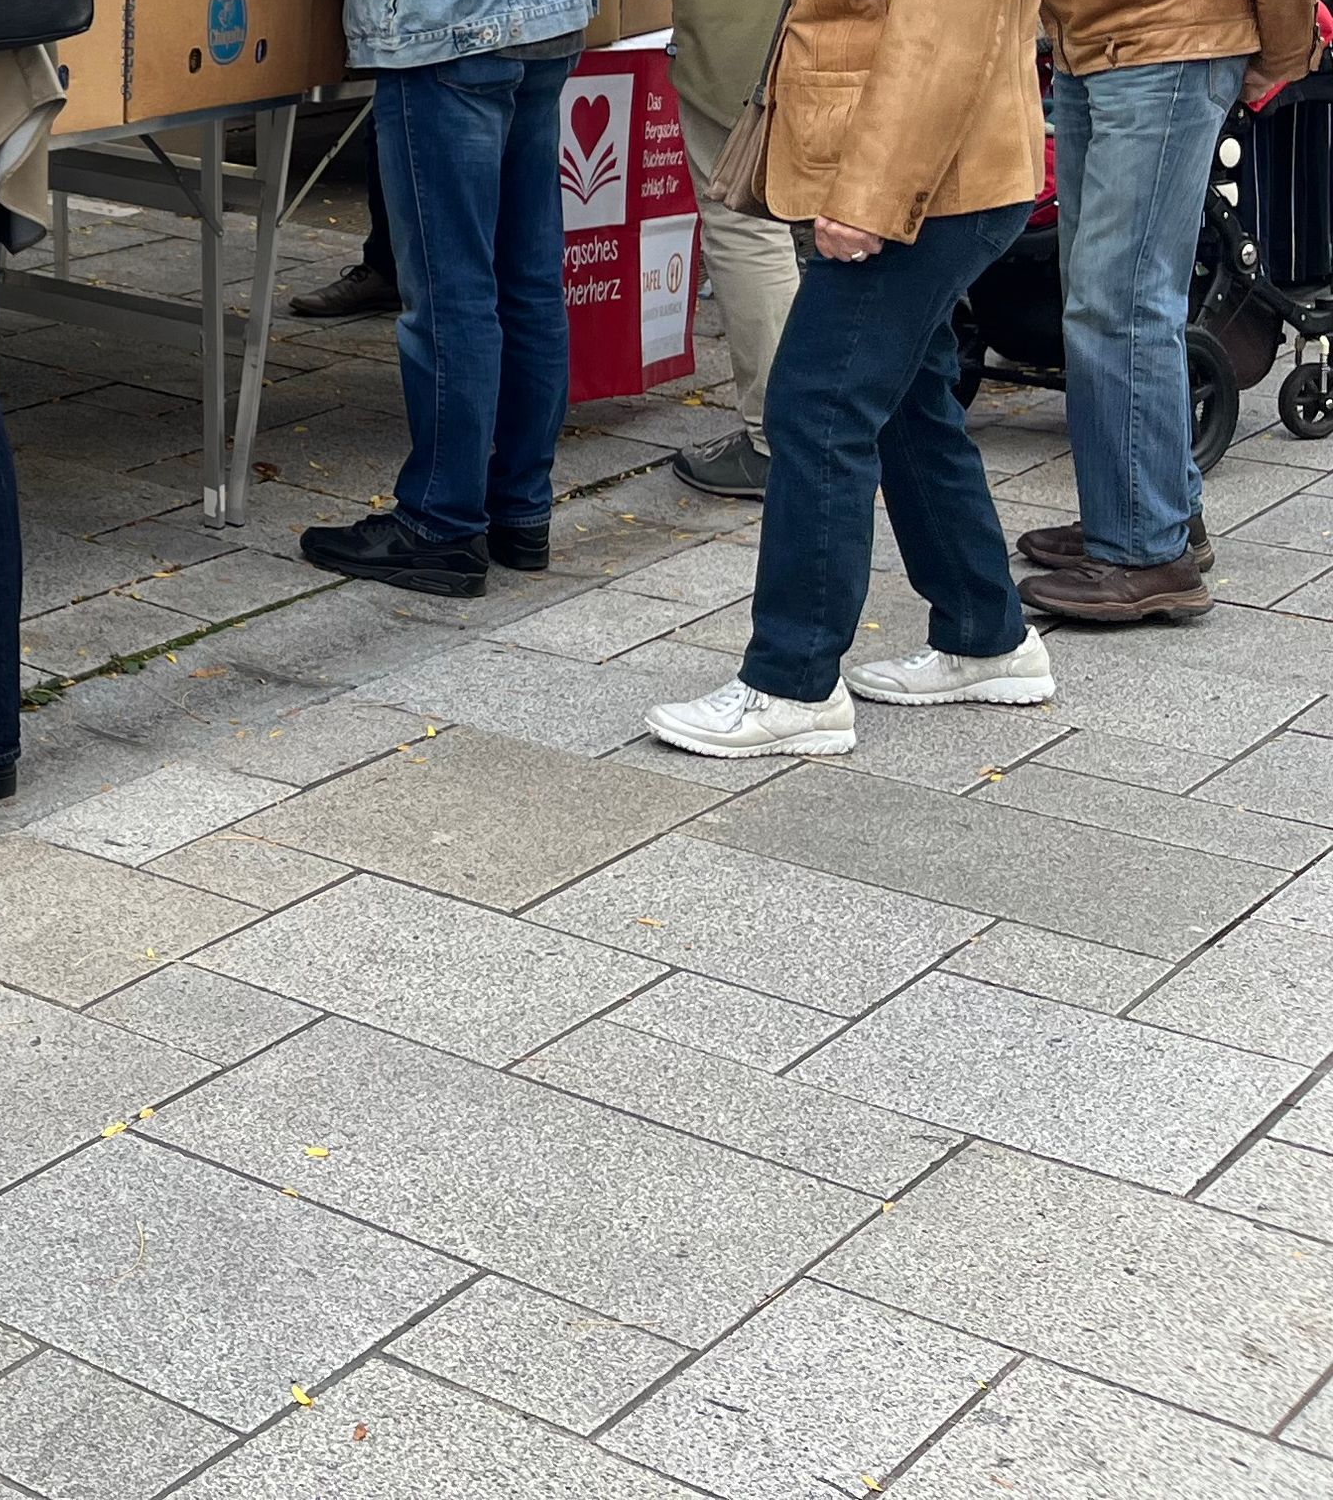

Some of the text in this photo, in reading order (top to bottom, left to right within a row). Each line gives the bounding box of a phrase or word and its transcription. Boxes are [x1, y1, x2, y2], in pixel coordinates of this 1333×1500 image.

[646, 91, 663, 112] Das
[644, 118, 680, 144] Bergische
[562, 234, 619, 273] rgisches
[562, 275, 622, 307] herherz
[642, 268, 662, 293] TAFEL
